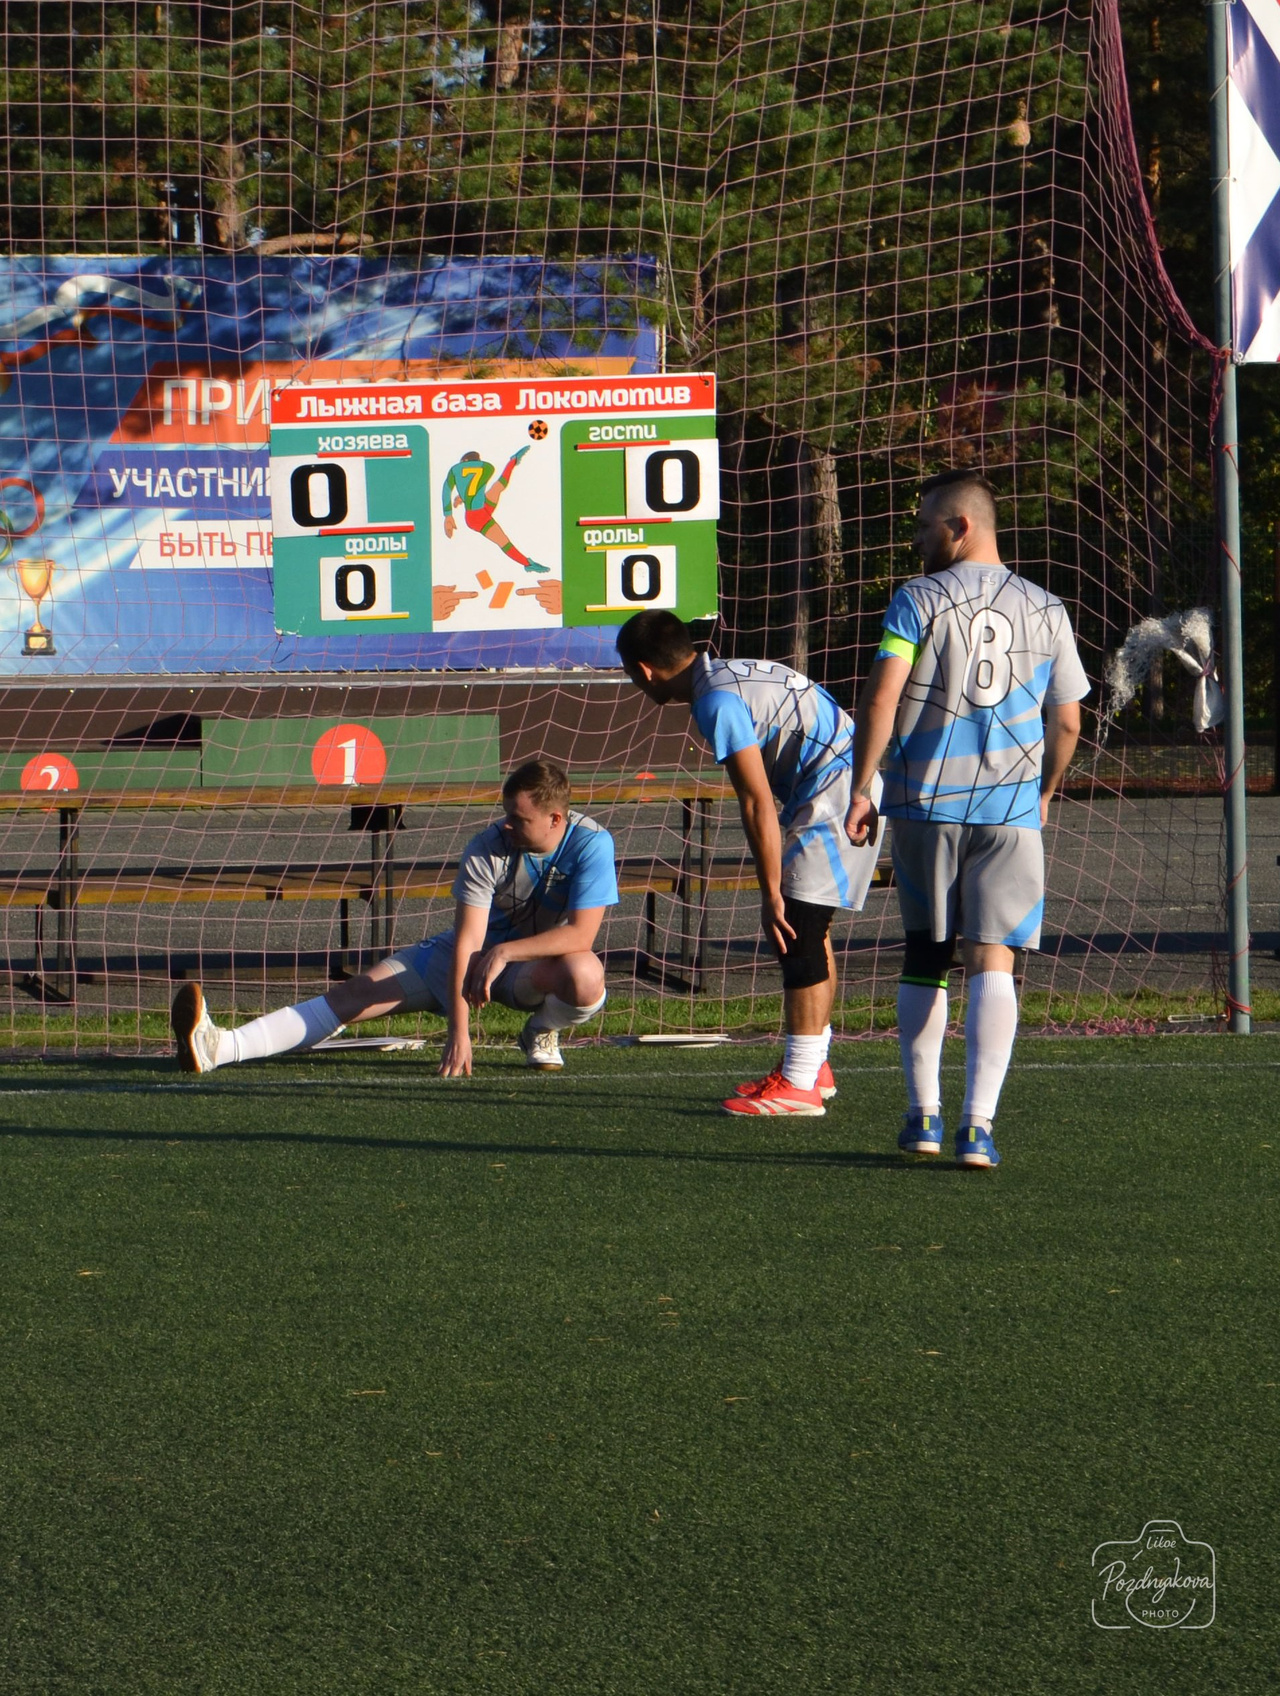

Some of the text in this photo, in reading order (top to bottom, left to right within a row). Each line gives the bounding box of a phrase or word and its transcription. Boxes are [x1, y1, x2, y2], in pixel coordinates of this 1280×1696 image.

[295, 386, 691, 418] Лыжная база Локомотив
[317, 433, 409, 451] хозяева
[588, 424, 658, 442] гости
[108, 466, 272, 499] УЧАСТНИ
[290, 463, 349, 528] 0
[461, 466, 484, 497] 7
[645, 449, 701, 513] 0
[159, 531, 238, 558] БЫТЬ
[345, 536, 407, 556] фолы
[583, 527, 644, 547] фолы
[335, 564, 376, 612] 0
[621, 554, 661, 602] 0
[961, 606, 1015, 709] 8
[336, 737, 361, 787] 1
